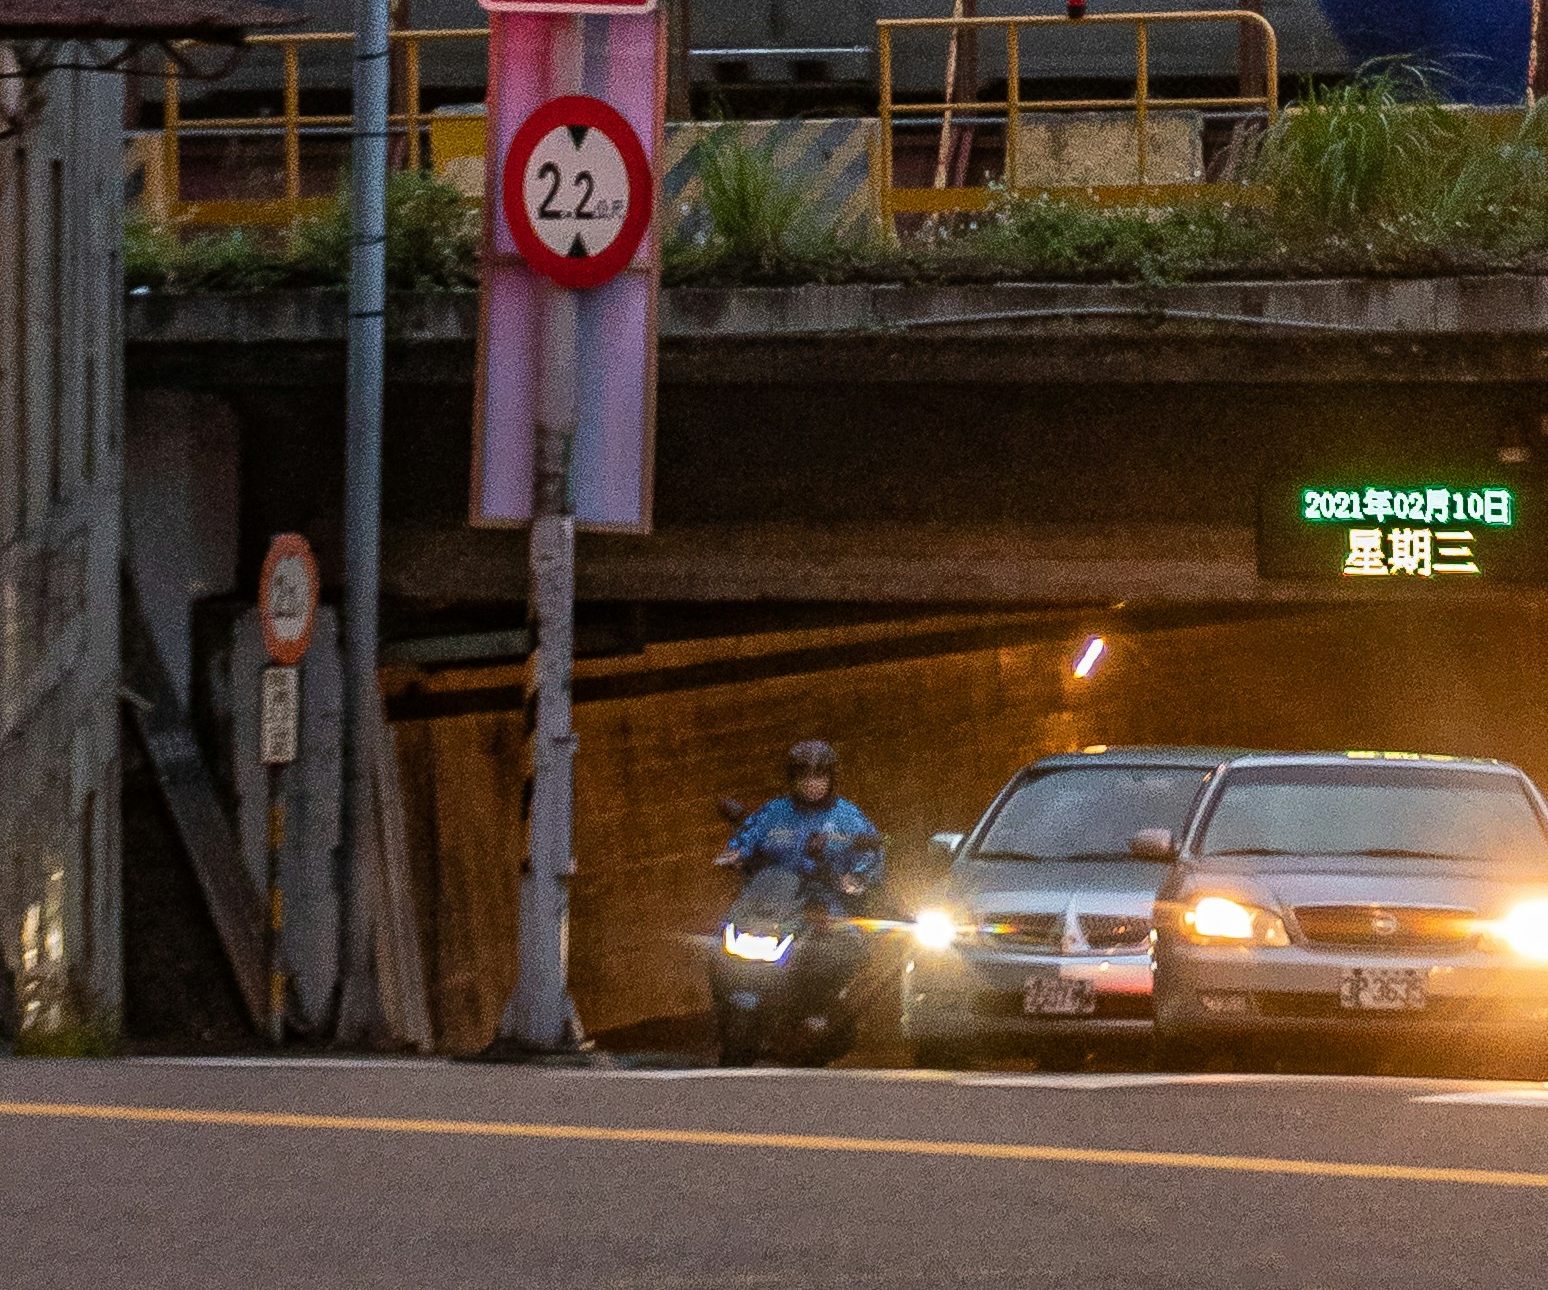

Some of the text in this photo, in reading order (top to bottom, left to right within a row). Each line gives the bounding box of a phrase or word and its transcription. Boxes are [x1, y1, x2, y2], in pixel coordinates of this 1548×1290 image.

[1304, 488, 1511, 525] 2021年02月10日
[1344, 528, 1480, 577] 星期三
